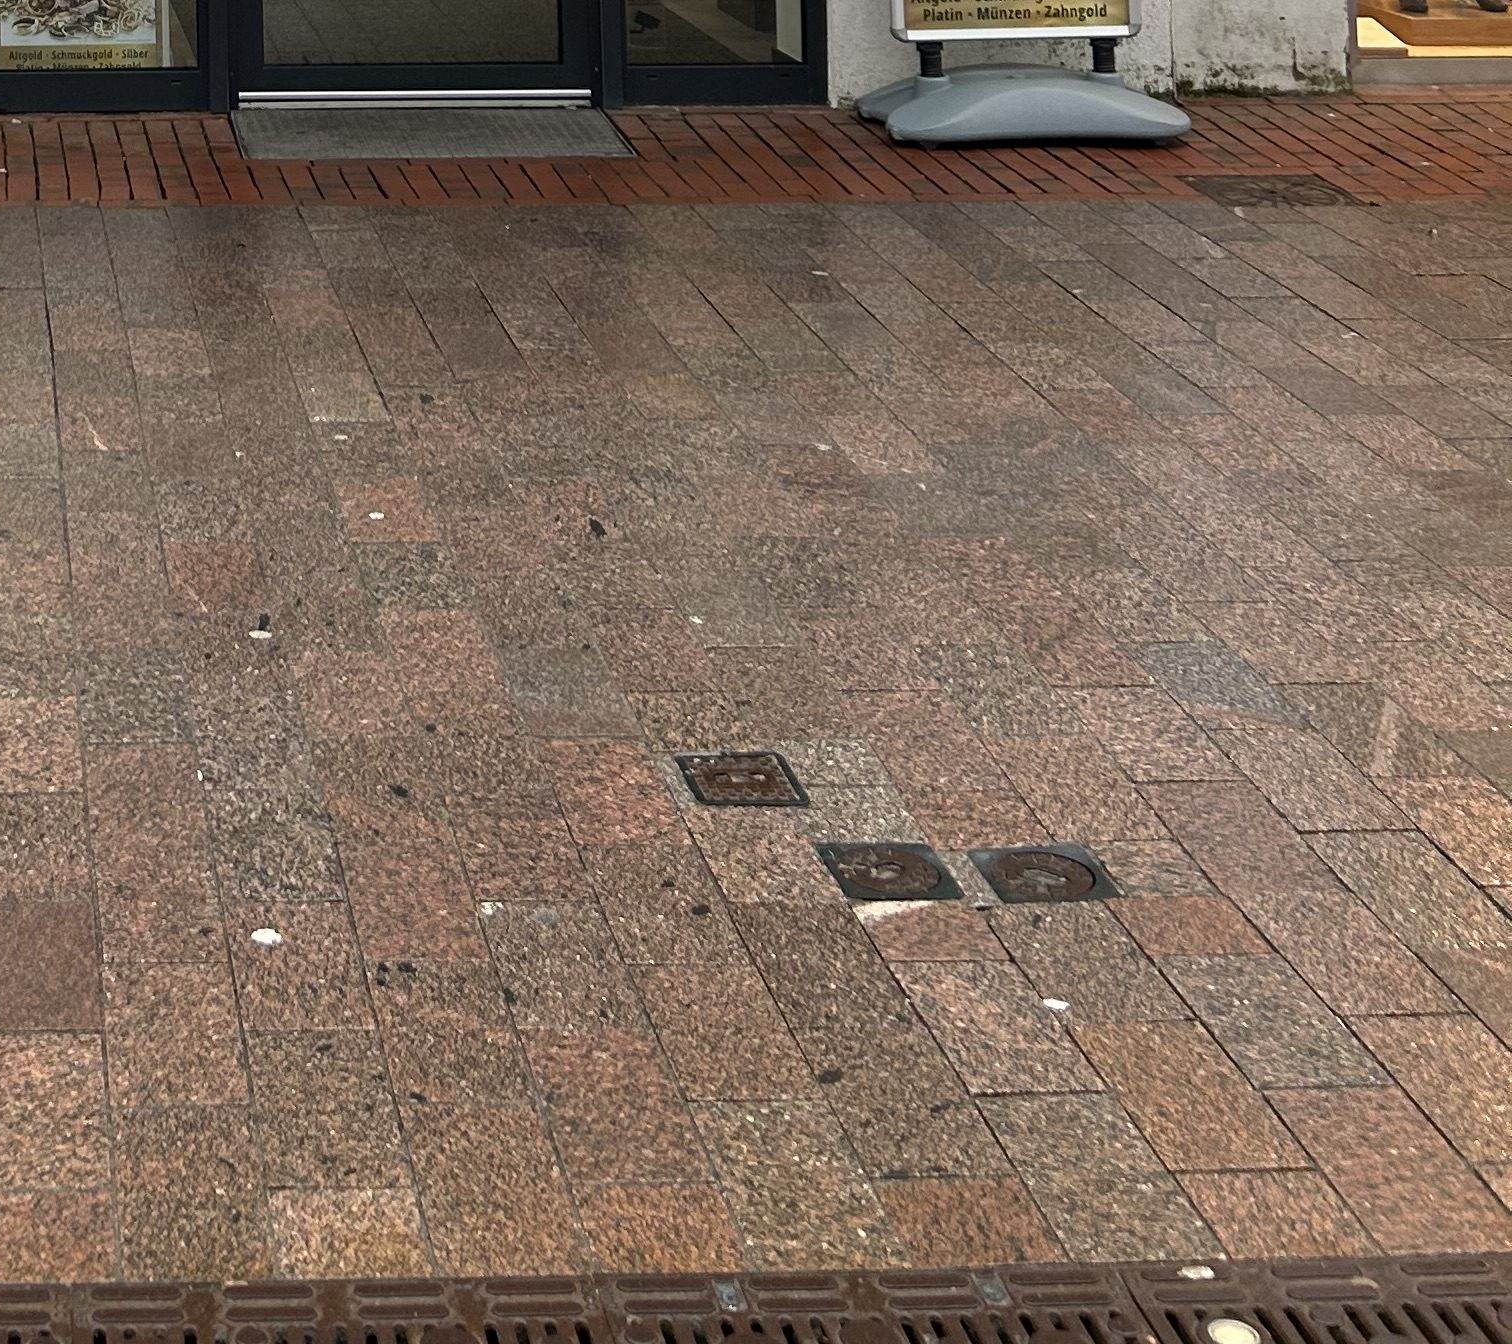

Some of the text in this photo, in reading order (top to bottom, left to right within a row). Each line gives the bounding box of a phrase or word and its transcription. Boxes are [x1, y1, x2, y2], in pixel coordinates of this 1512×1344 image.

[923, 4, 1108, 22] Platin Münzen Zahngold
[9, 50, 42, 62] Altgold
[51, 49, 113, 61] Schmuckgold
